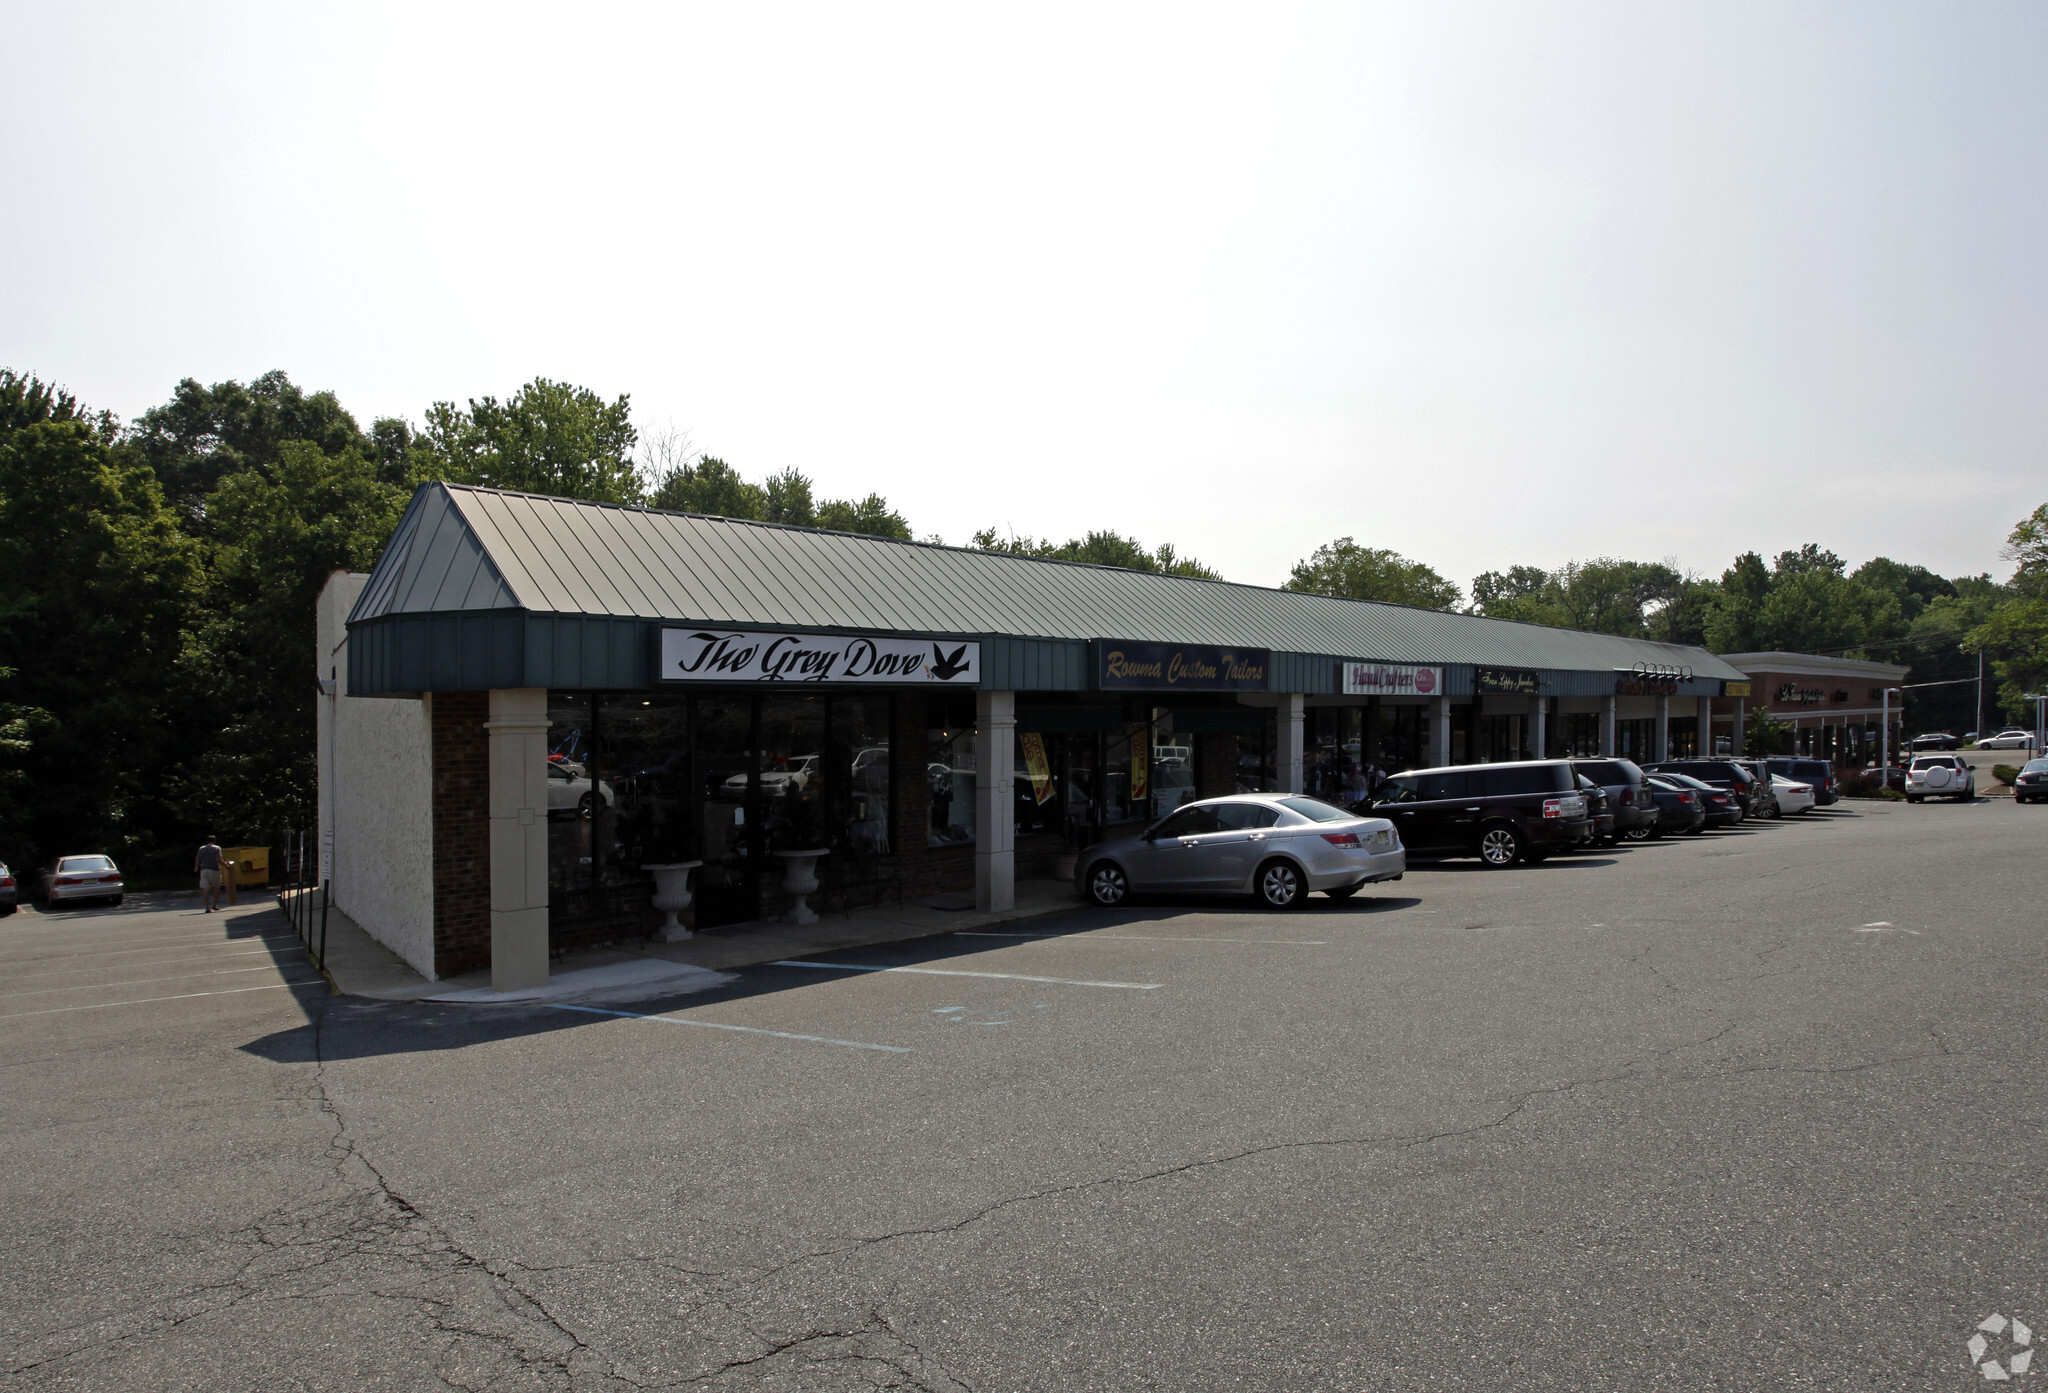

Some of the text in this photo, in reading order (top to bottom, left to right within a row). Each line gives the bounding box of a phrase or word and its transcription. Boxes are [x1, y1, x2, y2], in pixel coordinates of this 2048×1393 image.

[678, 632, 926, 681] The Grey Dove
[1167, 652, 1217, 684] Custom
[1222, 654, 1263, 681] Tailors
